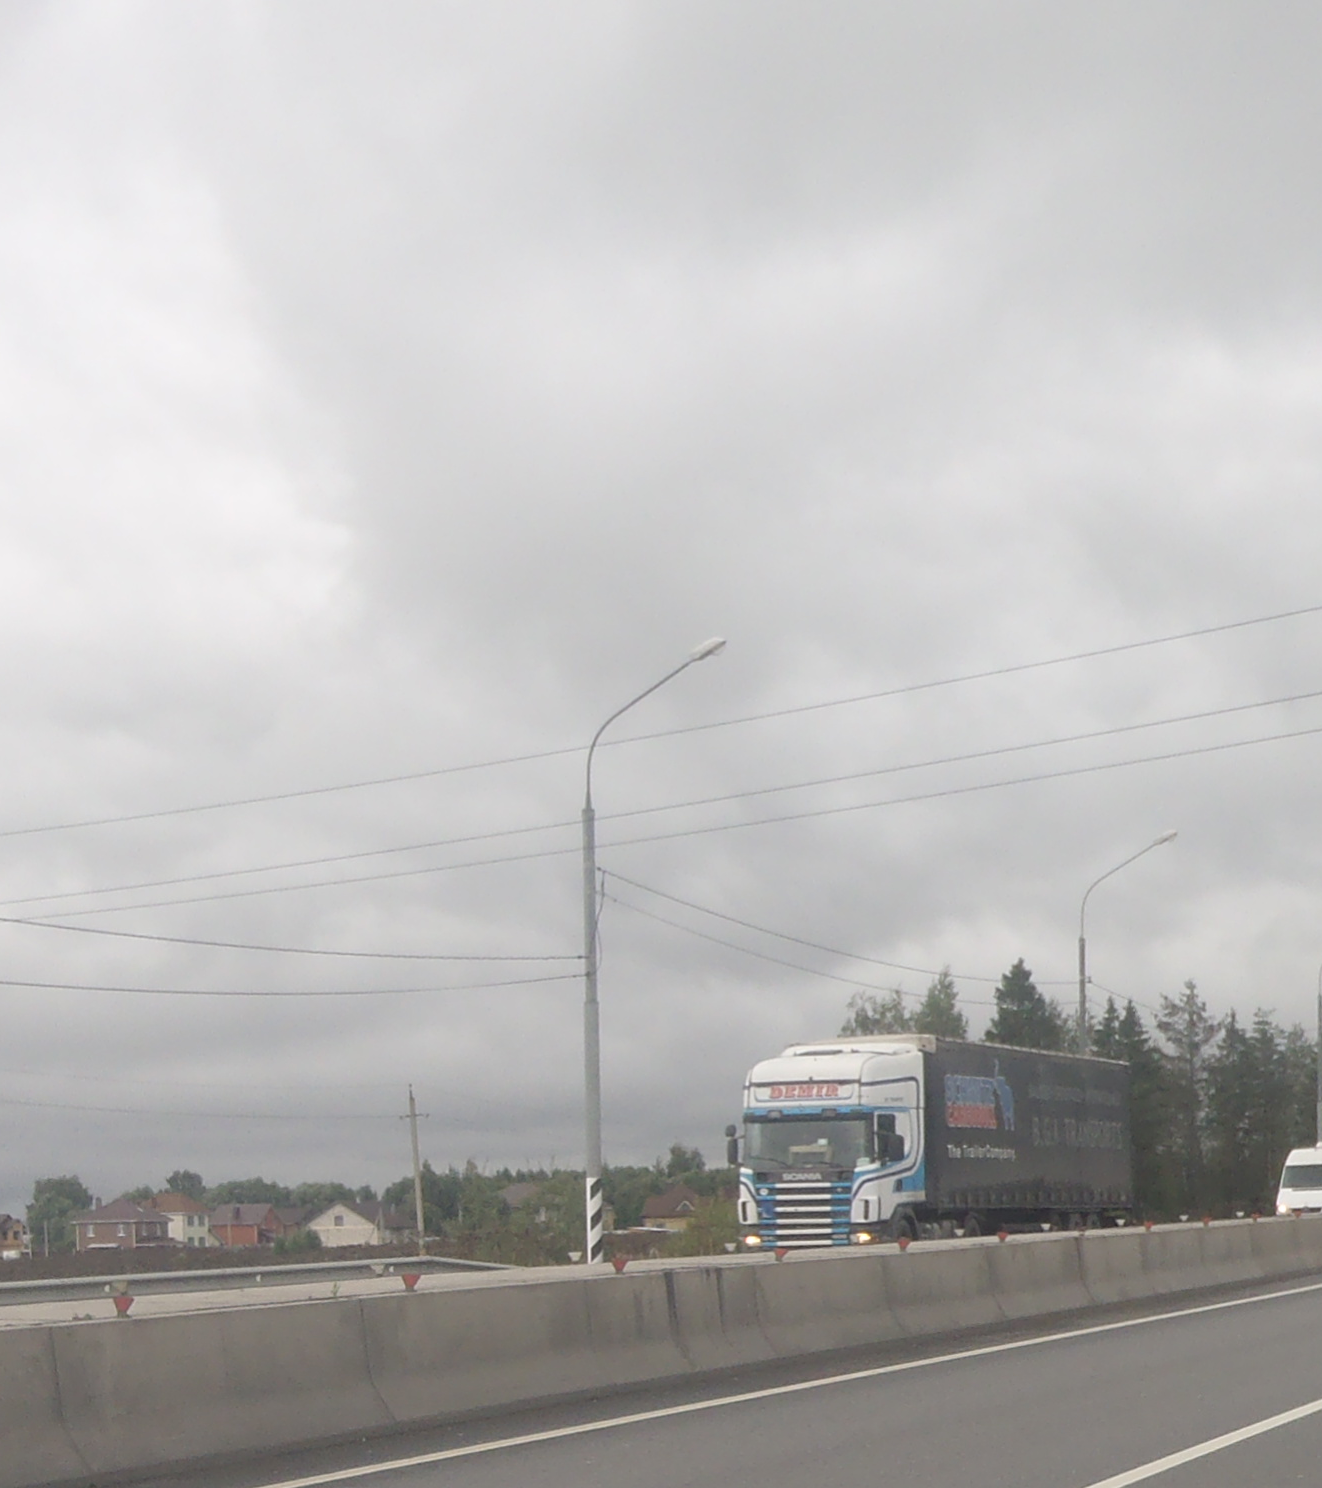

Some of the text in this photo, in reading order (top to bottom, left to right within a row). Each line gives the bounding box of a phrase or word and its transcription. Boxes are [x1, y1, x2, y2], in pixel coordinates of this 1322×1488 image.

[769, 1084, 841, 1099] DEMIR
[947, 1144, 962, 1159] The
[782, 1172, 823, 1182] SCANIA
